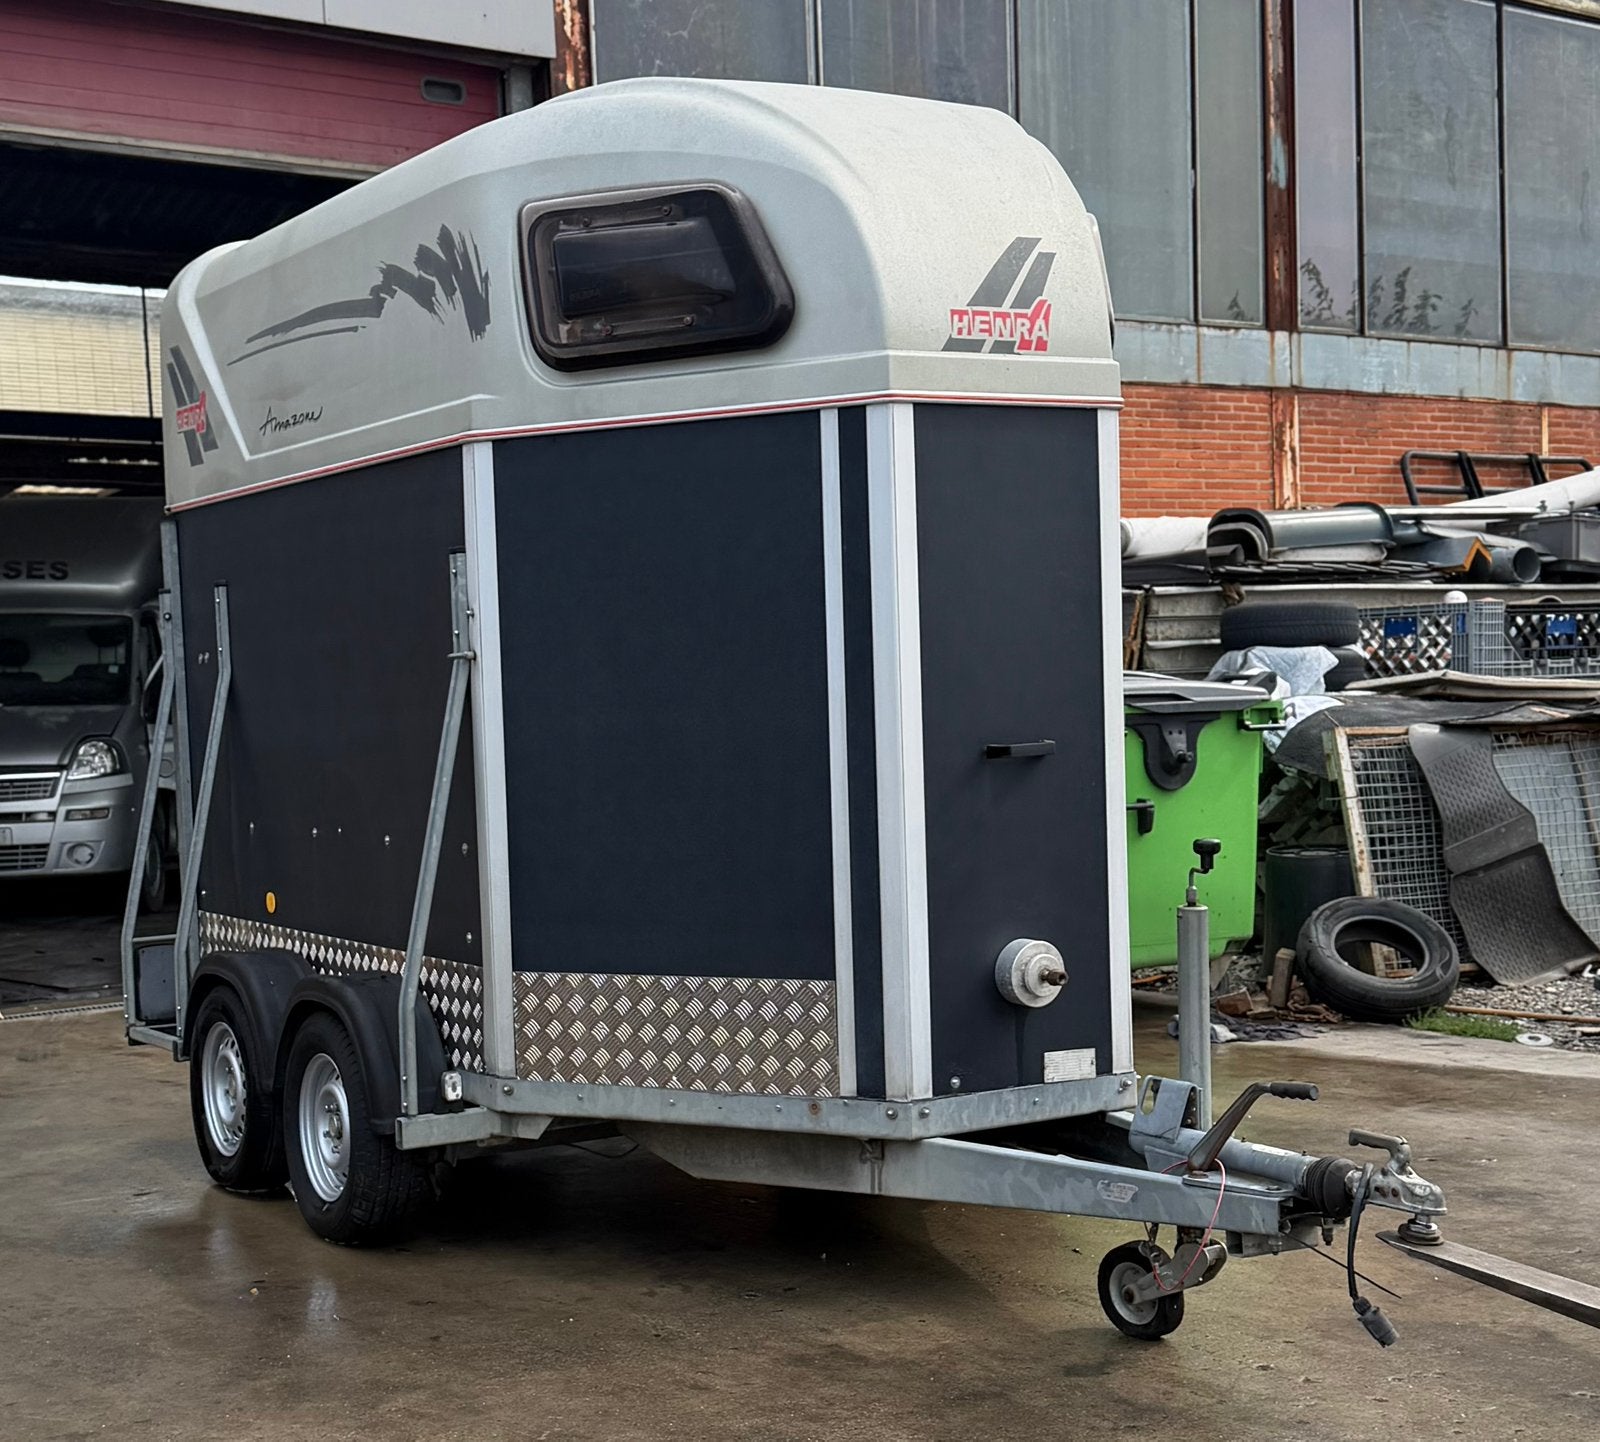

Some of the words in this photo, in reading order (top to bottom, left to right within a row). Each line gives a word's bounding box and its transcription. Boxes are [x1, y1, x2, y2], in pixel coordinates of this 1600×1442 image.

[950, 307, 1051, 345] HENRA
[259, 405, 323, 436] Amazone
[2, 560, 69, 581] SES
